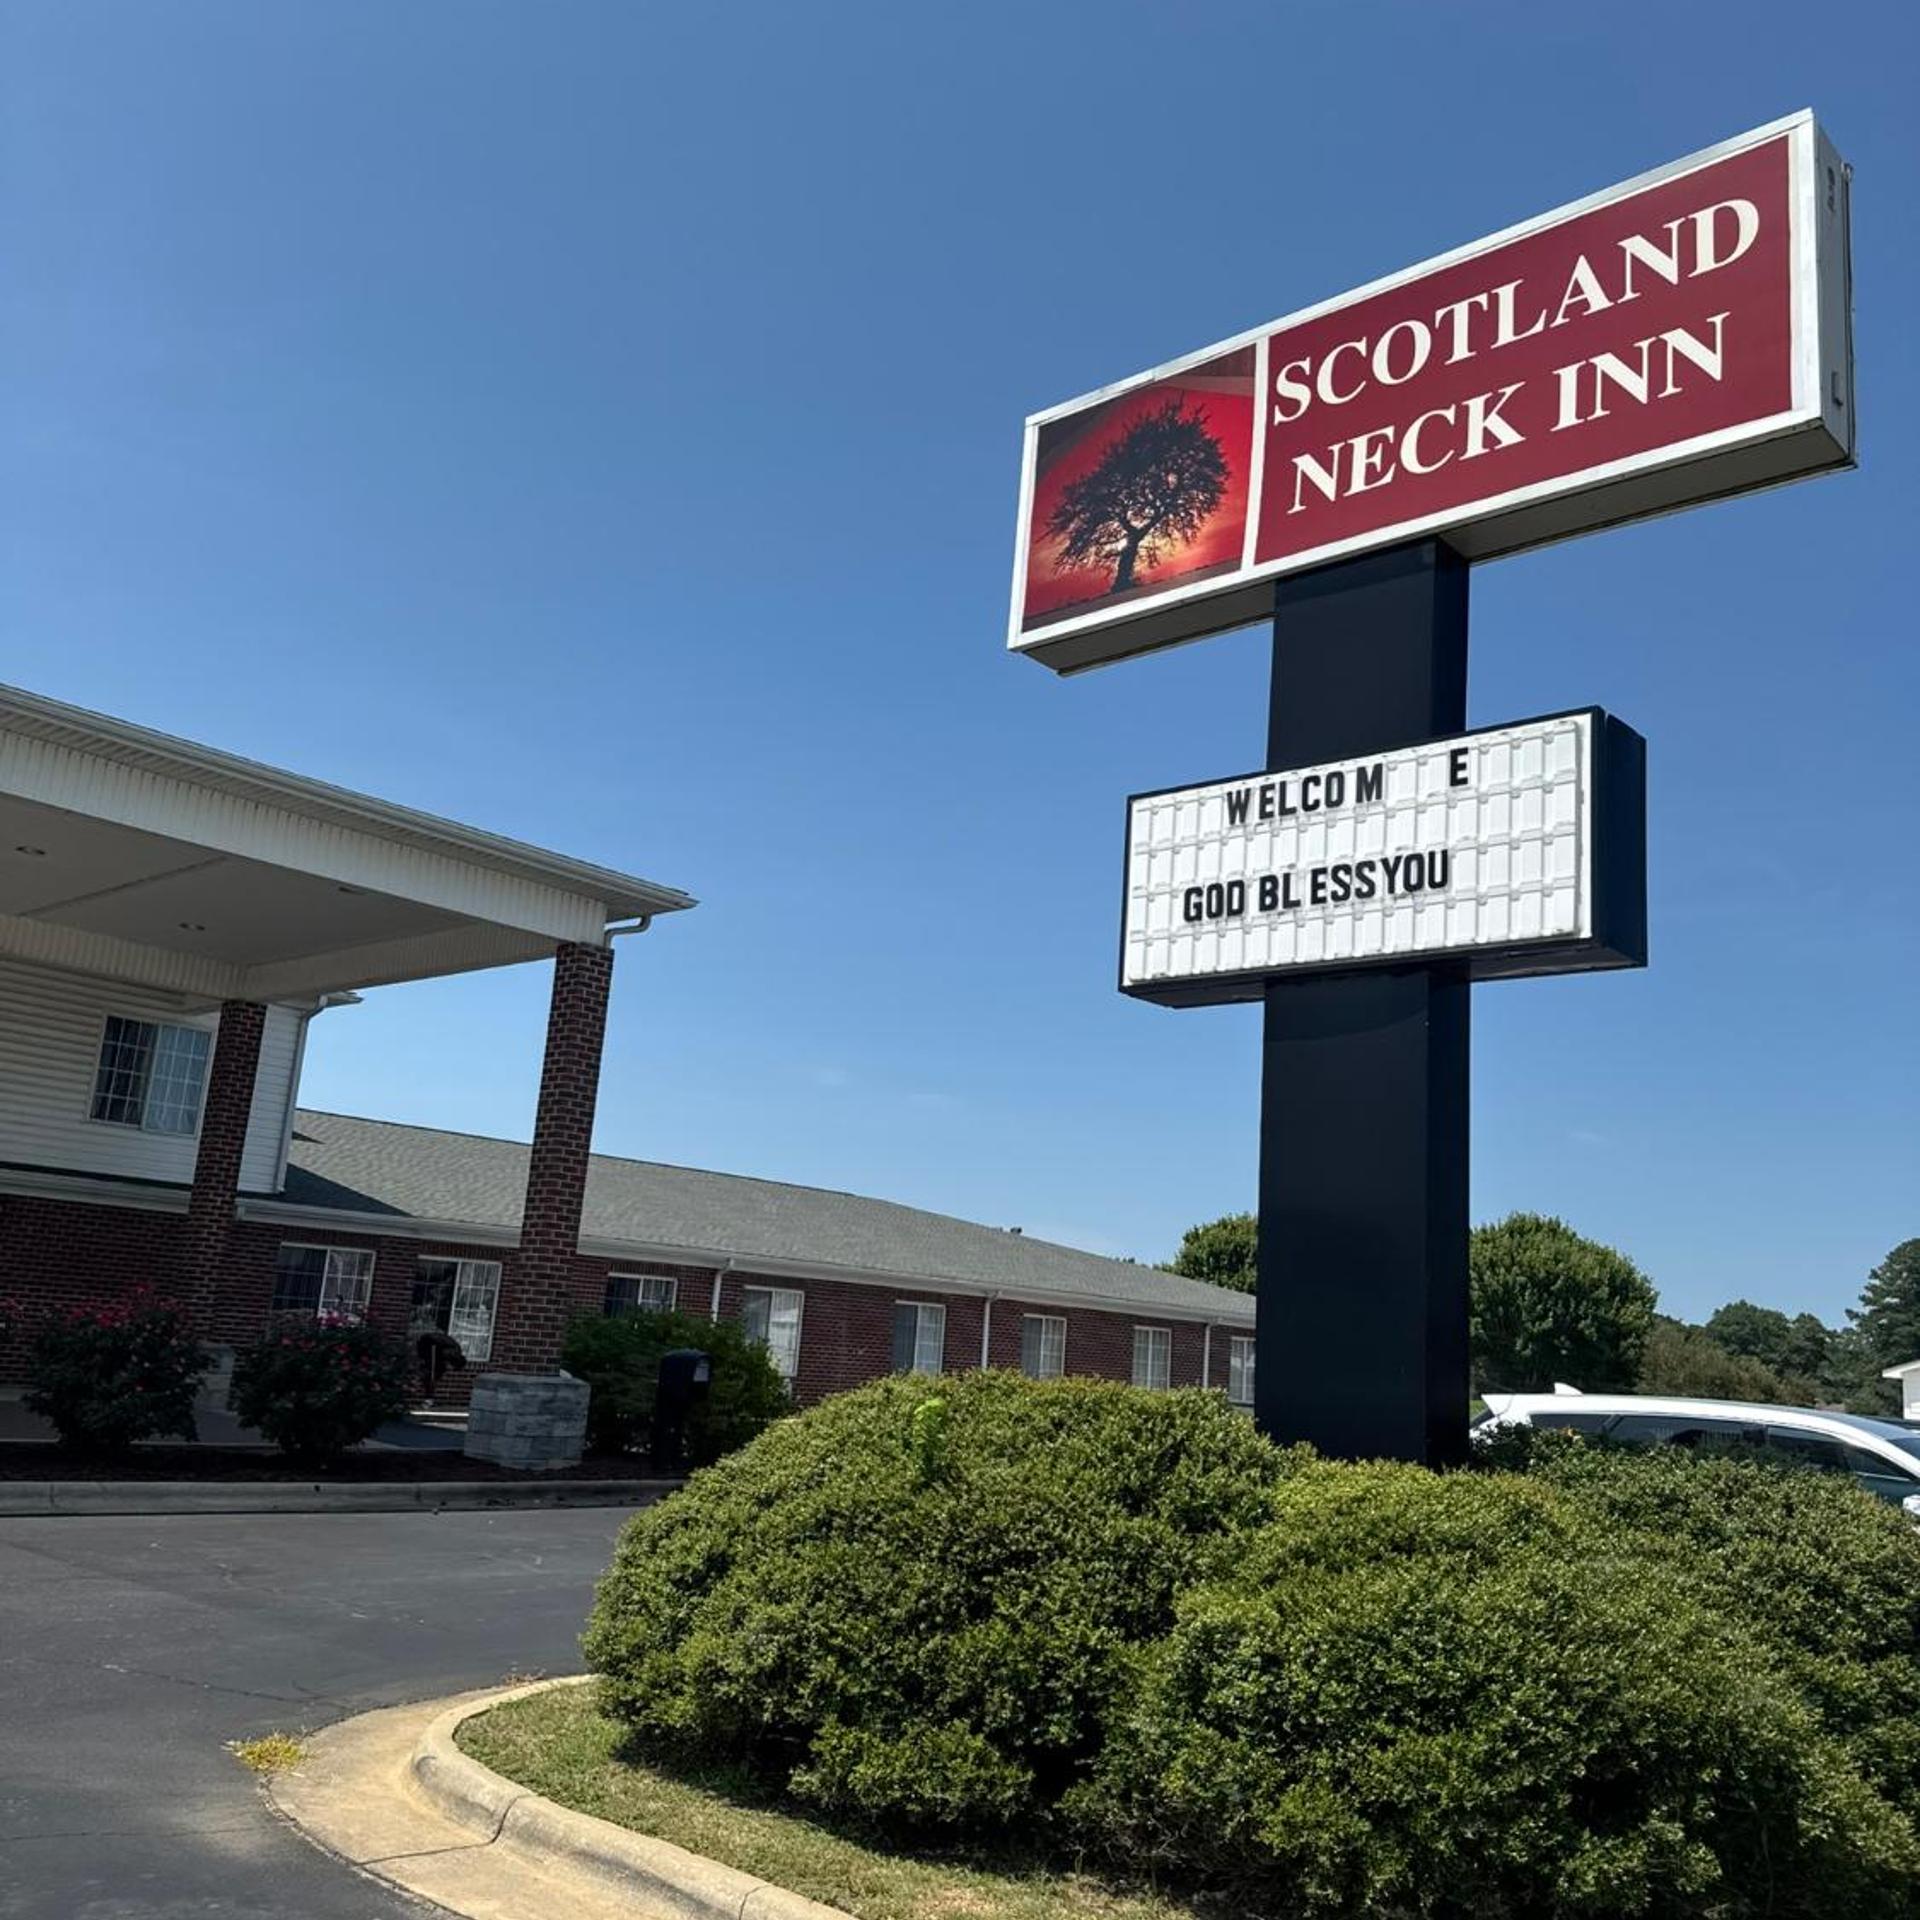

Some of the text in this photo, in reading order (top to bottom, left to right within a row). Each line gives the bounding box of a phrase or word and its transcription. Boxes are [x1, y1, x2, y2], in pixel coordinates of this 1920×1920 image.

[1273, 199, 1760, 426] SCOTLAND
[1287, 311, 1732, 514] NECK INN
[1183, 879, 1246, 923] GOD
